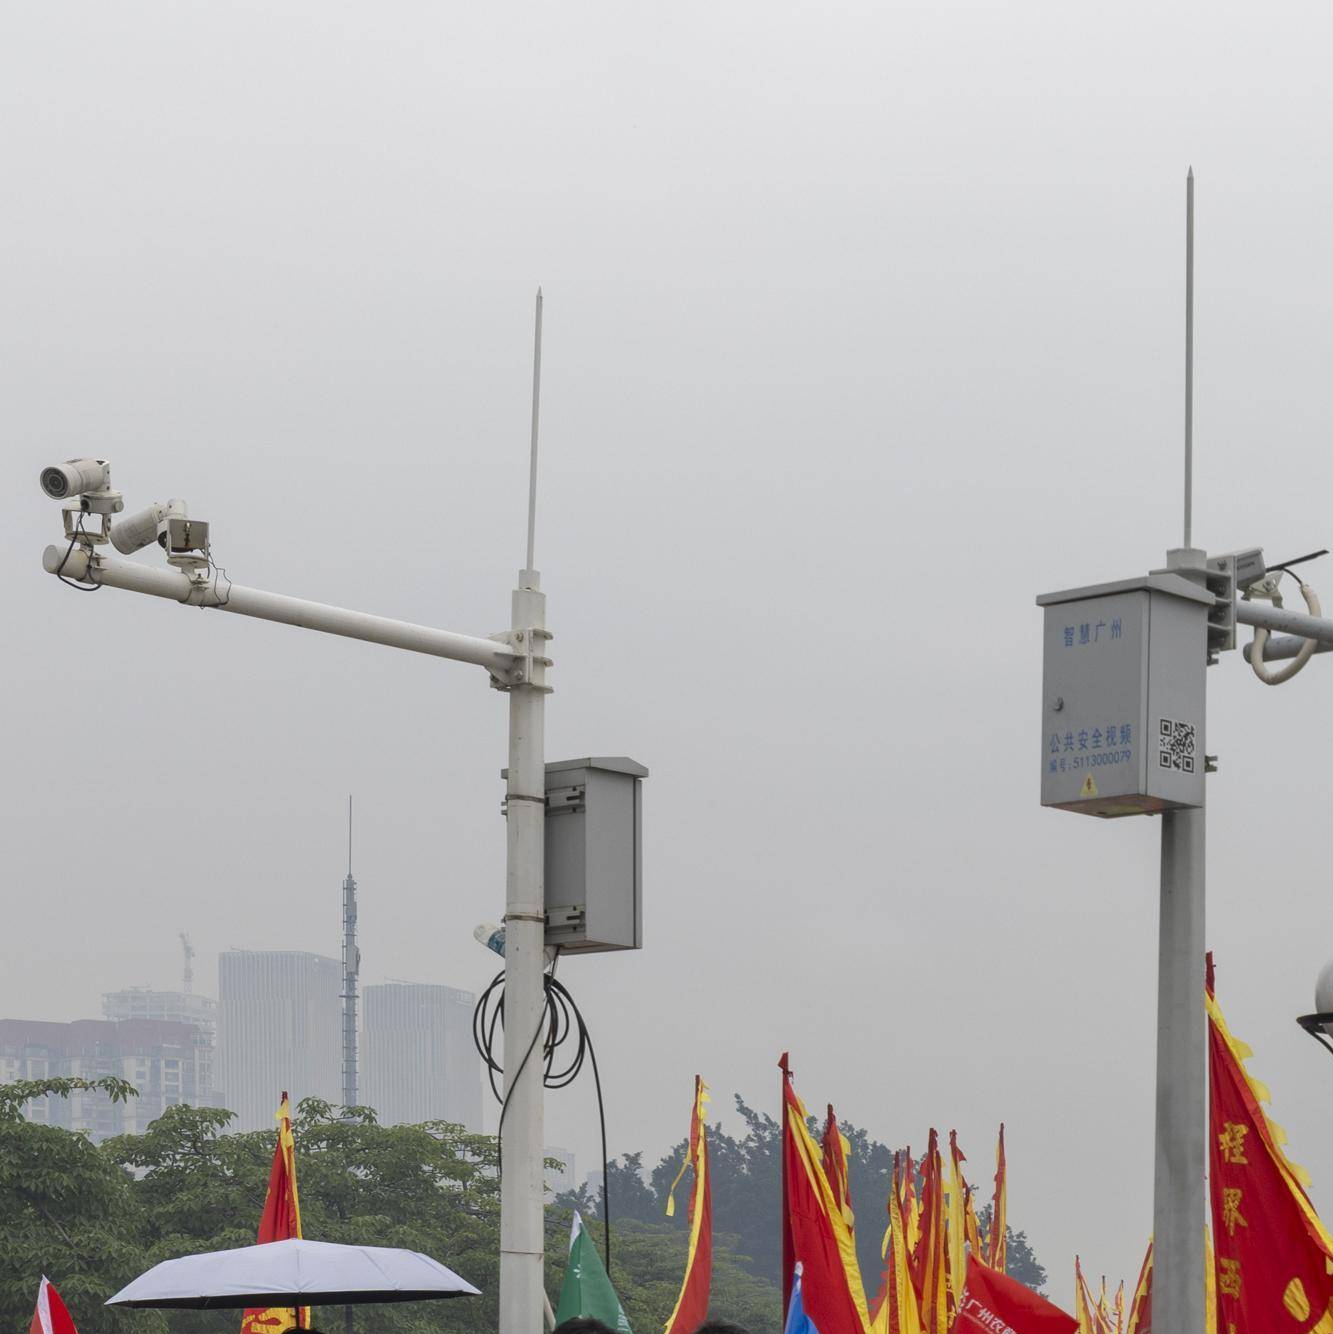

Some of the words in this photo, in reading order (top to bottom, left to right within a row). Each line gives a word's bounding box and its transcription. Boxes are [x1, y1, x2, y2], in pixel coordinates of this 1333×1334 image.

[1064, 618, 1122, 647] 智慧广州
[1050, 724, 1131, 753] 公共安全视频
